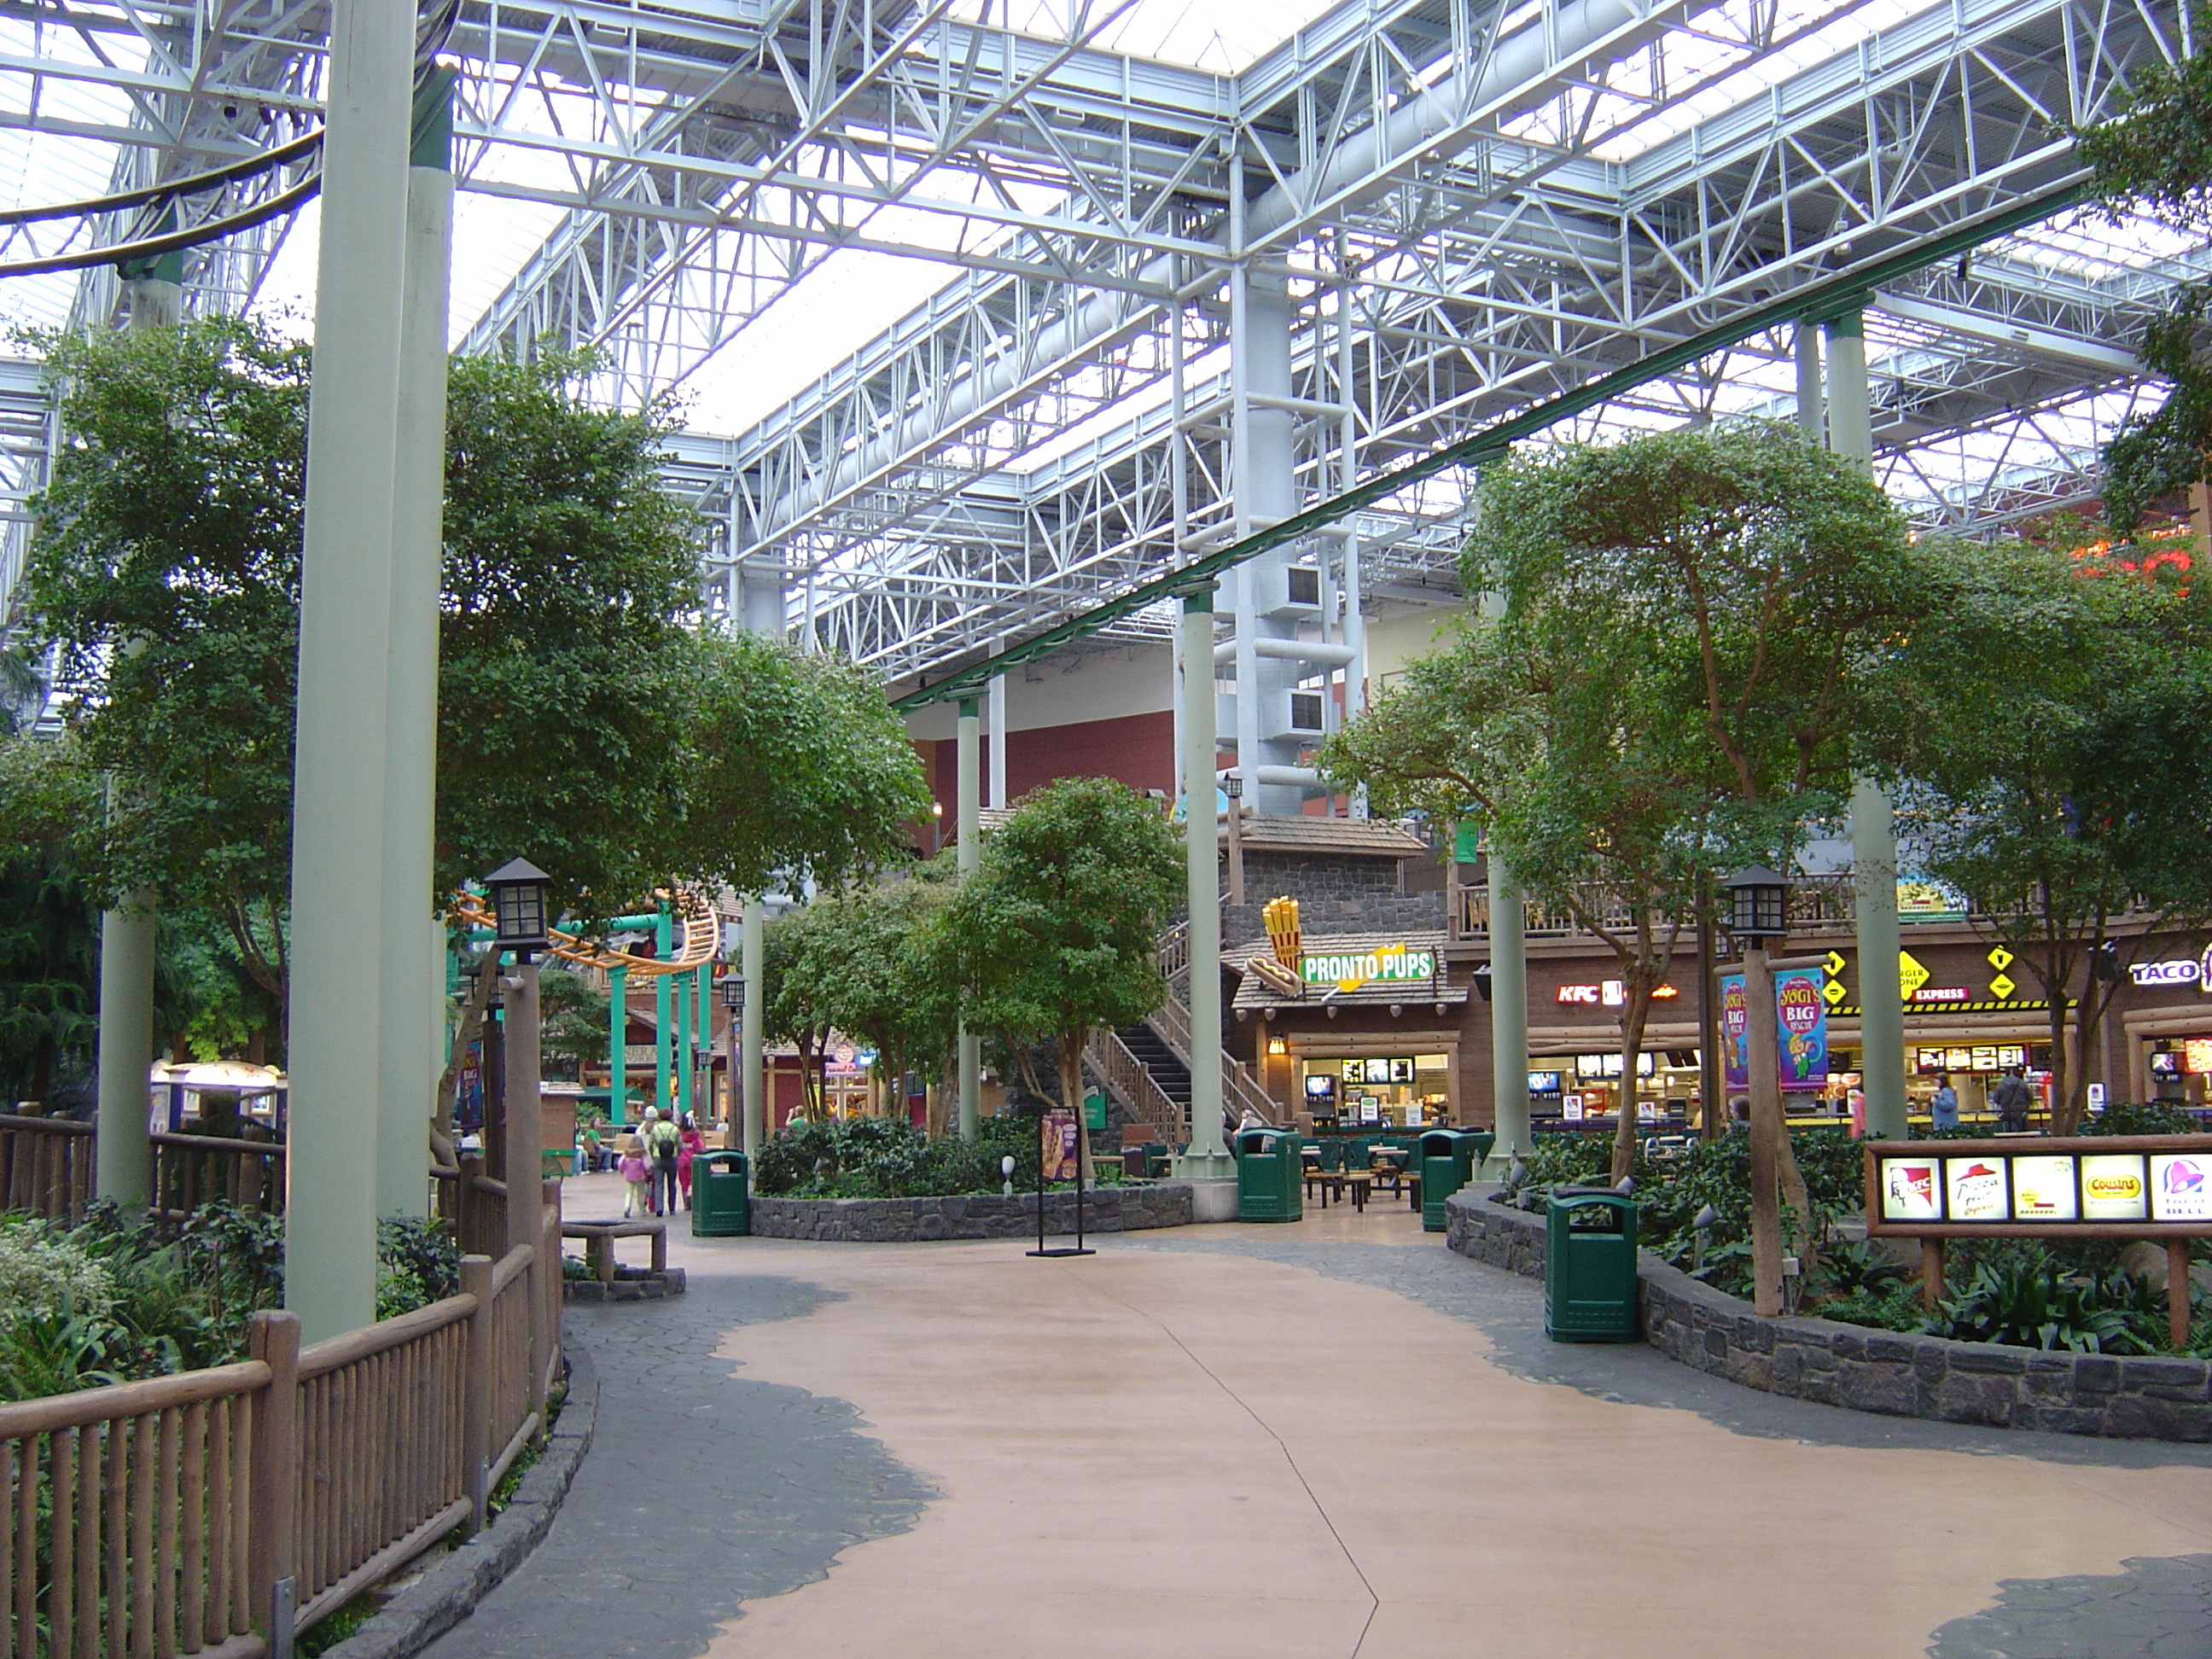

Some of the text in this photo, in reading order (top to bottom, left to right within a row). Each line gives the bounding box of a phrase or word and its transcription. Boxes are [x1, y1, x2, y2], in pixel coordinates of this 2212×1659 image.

[1276, 946, 1298, 956] FRIES
[1305, 952, 1430, 981] PRONTO PUPS
[2131, 964, 2197, 981] TACO
[1900, 978, 1919, 987] ONE
[1557, 985, 1598, 1002] KFC
[1780, 987, 1821, 1005] YOGI'S
[1916, 988, 1965, 999] EXPRESS
[1727, 1010, 1744, 1024] BIG
[1786, 1006, 1815, 1021] BIG
[1908, 1177, 1930, 1192] KFC
[2092, 1179, 2134, 1190] Cousins
